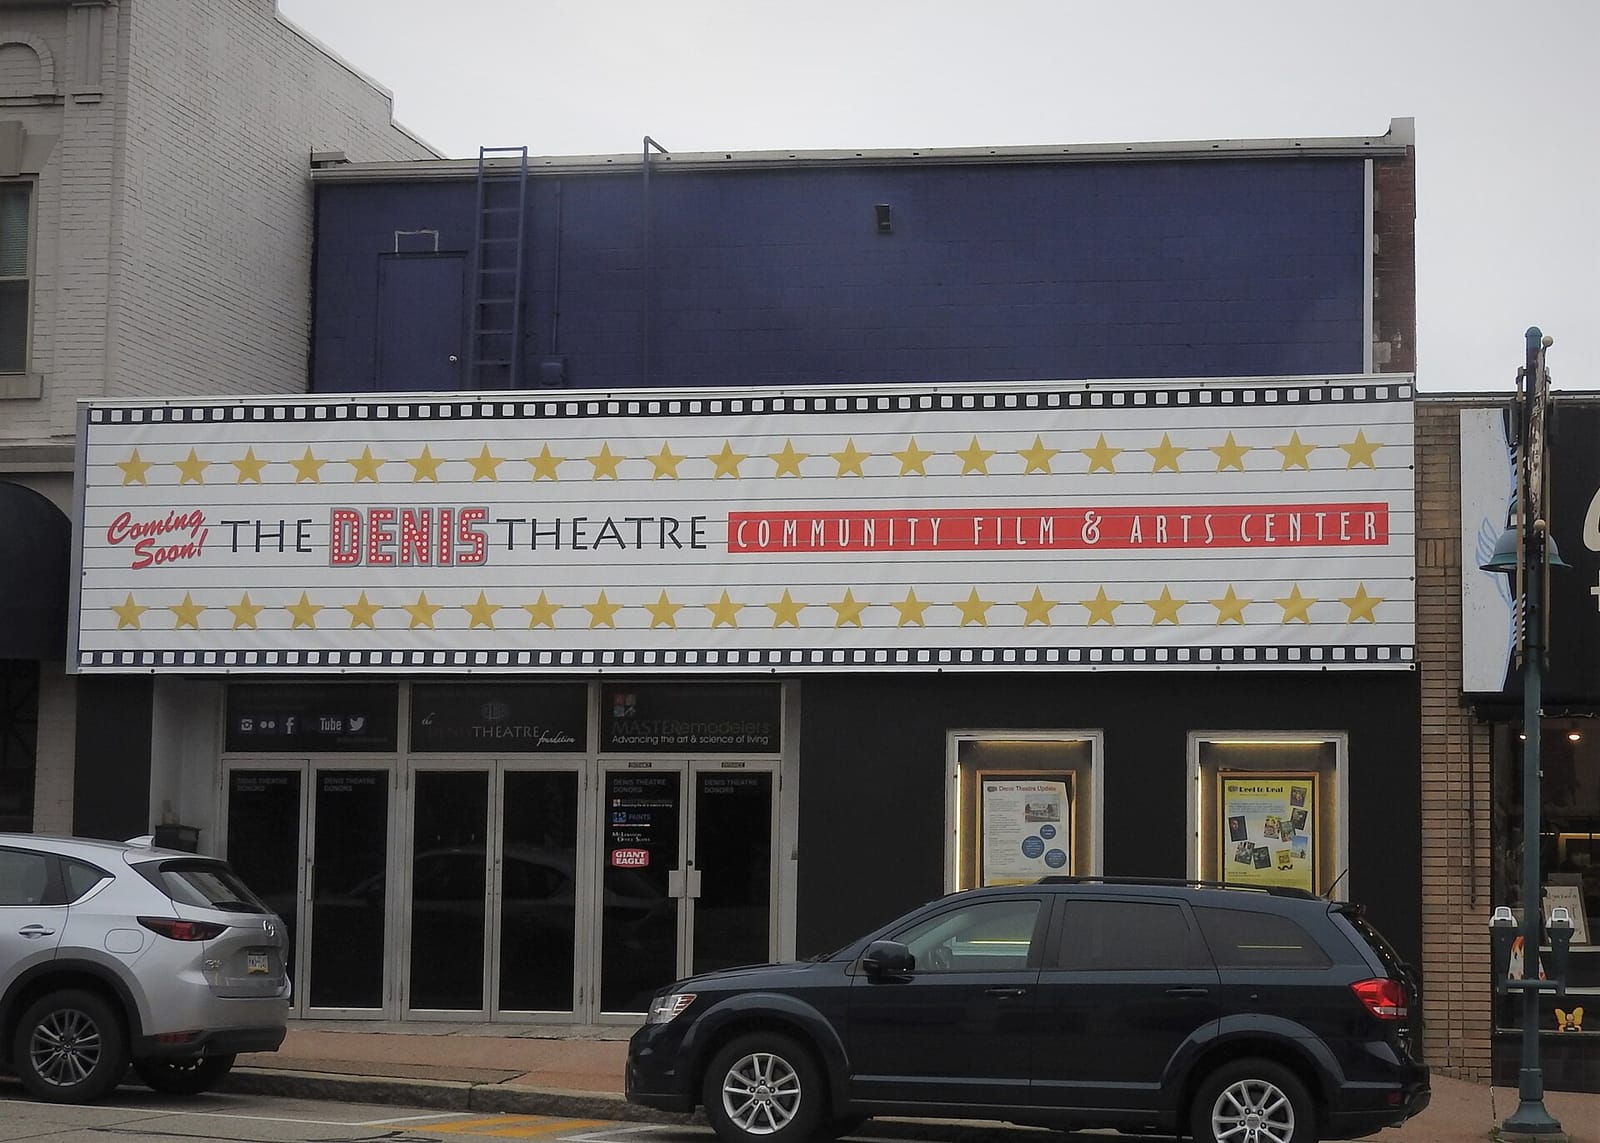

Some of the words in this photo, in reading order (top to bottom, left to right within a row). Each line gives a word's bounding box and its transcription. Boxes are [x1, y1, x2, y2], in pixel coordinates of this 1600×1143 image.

[107, 510, 206, 545] Coming
[736, 516, 942, 547] COMMUNITY
[973, 515, 1054, 545] FILM
[1081, 510, 1103, 545] &
[1130, 514, 1213, 545] ARTS
[1239, 510, 1377, 543] CENTER
[221, 519, 313, 553] THE
[329, 506, 490, 568] DENIS
[496, 515, 707, 550] THEATRE
[131, 528, 209, 570] Soon!
[319, 717, 342, 731] Tube
[472, 726, 540, 738] THEATRE
[611, 735, 659, 746] Advancing
[660, 734, 676, 744] the
[676, 735, 689, 744] art
[690, 734, 697, 744] &
[699, 735, 734, 744] science
[735, 734, 746, 744] of
[747, 734, 769, 746] living
[636, 778, 667, 786] THEATRE
[615, 851, 646, 859] GIANT
[615, 858, 645, 866] EAGLE
